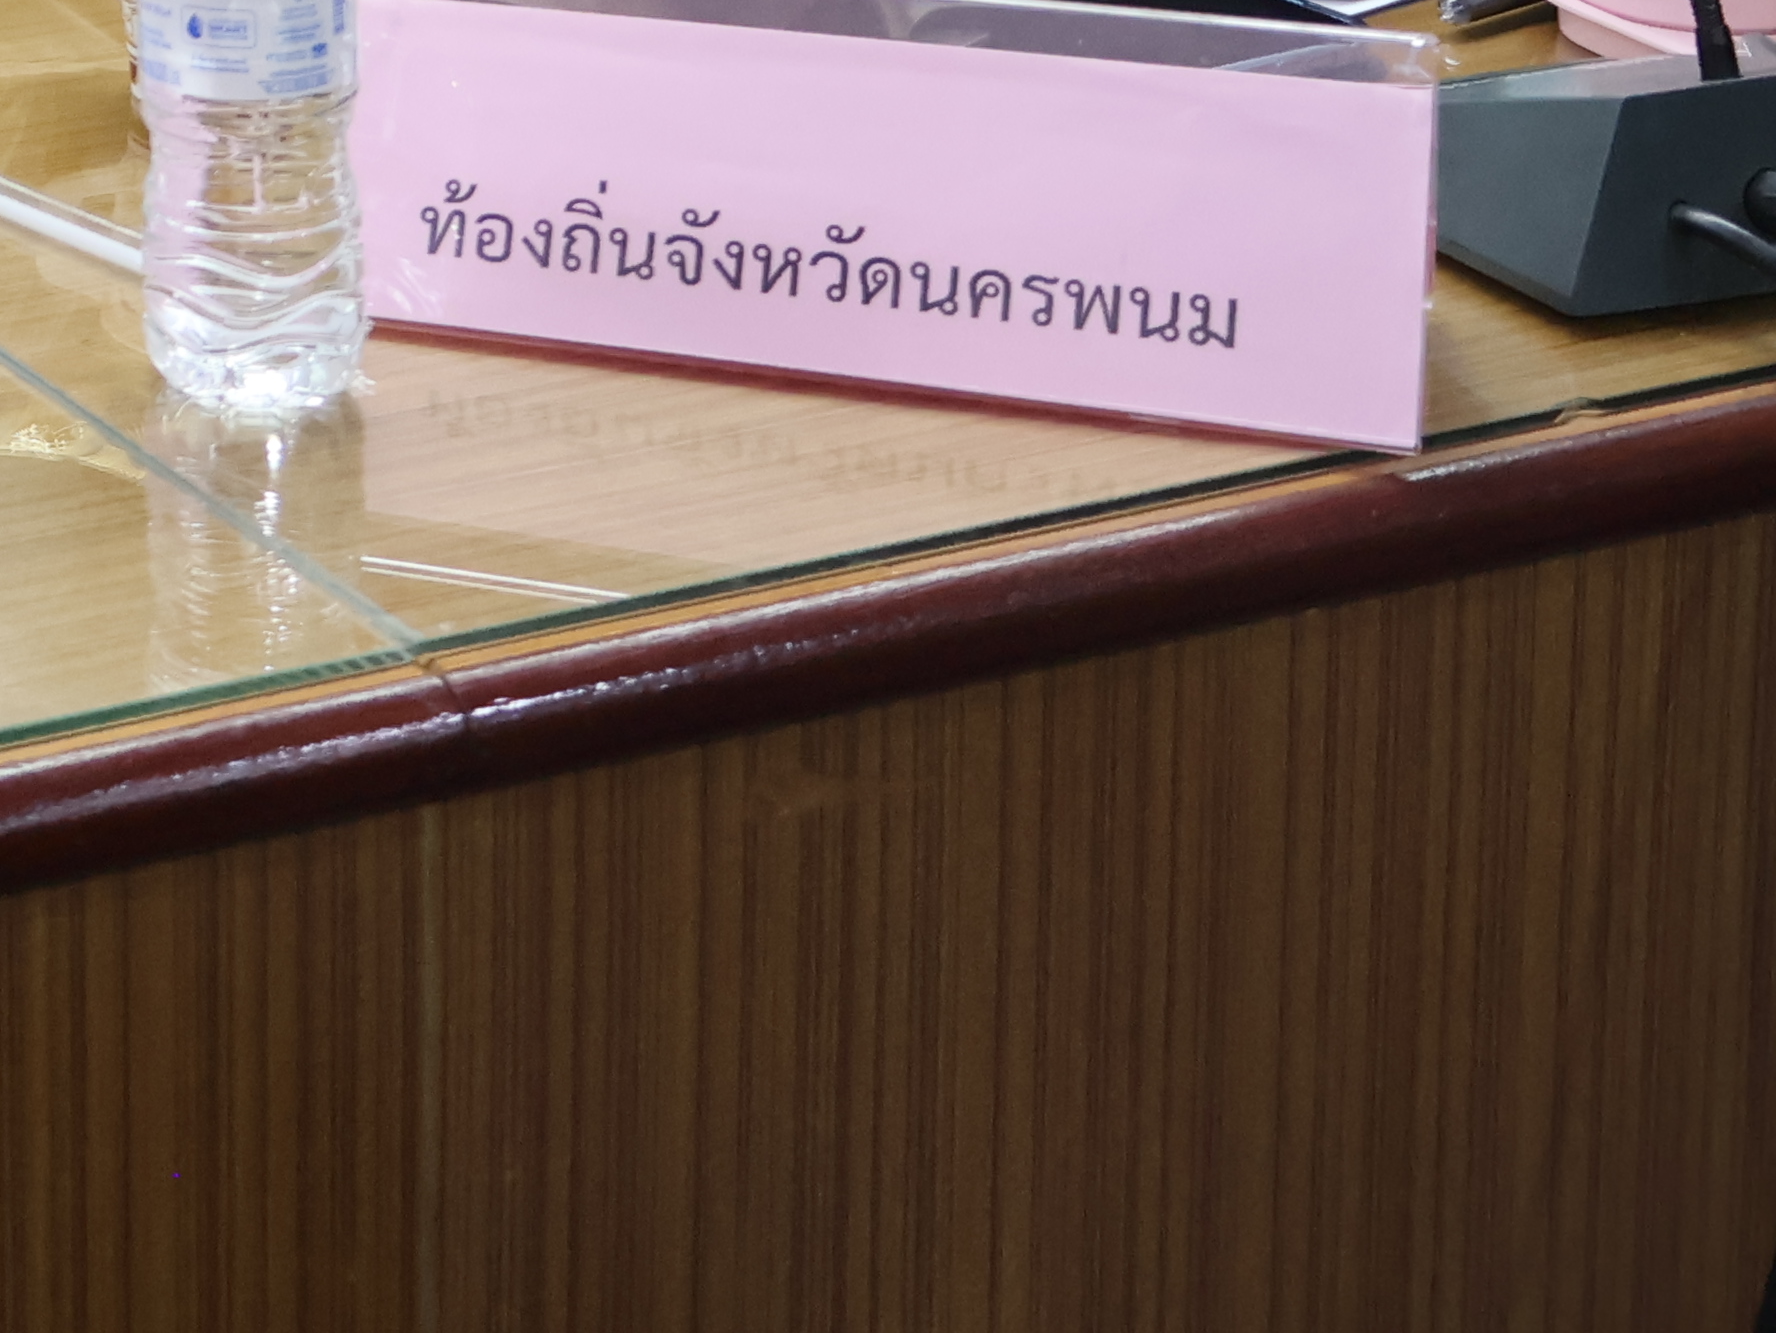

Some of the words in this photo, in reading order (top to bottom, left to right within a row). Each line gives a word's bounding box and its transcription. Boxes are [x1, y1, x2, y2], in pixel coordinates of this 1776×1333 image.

[418, 177, 1239, 351] ท้องถิ่นจังหวัดนครพนม
